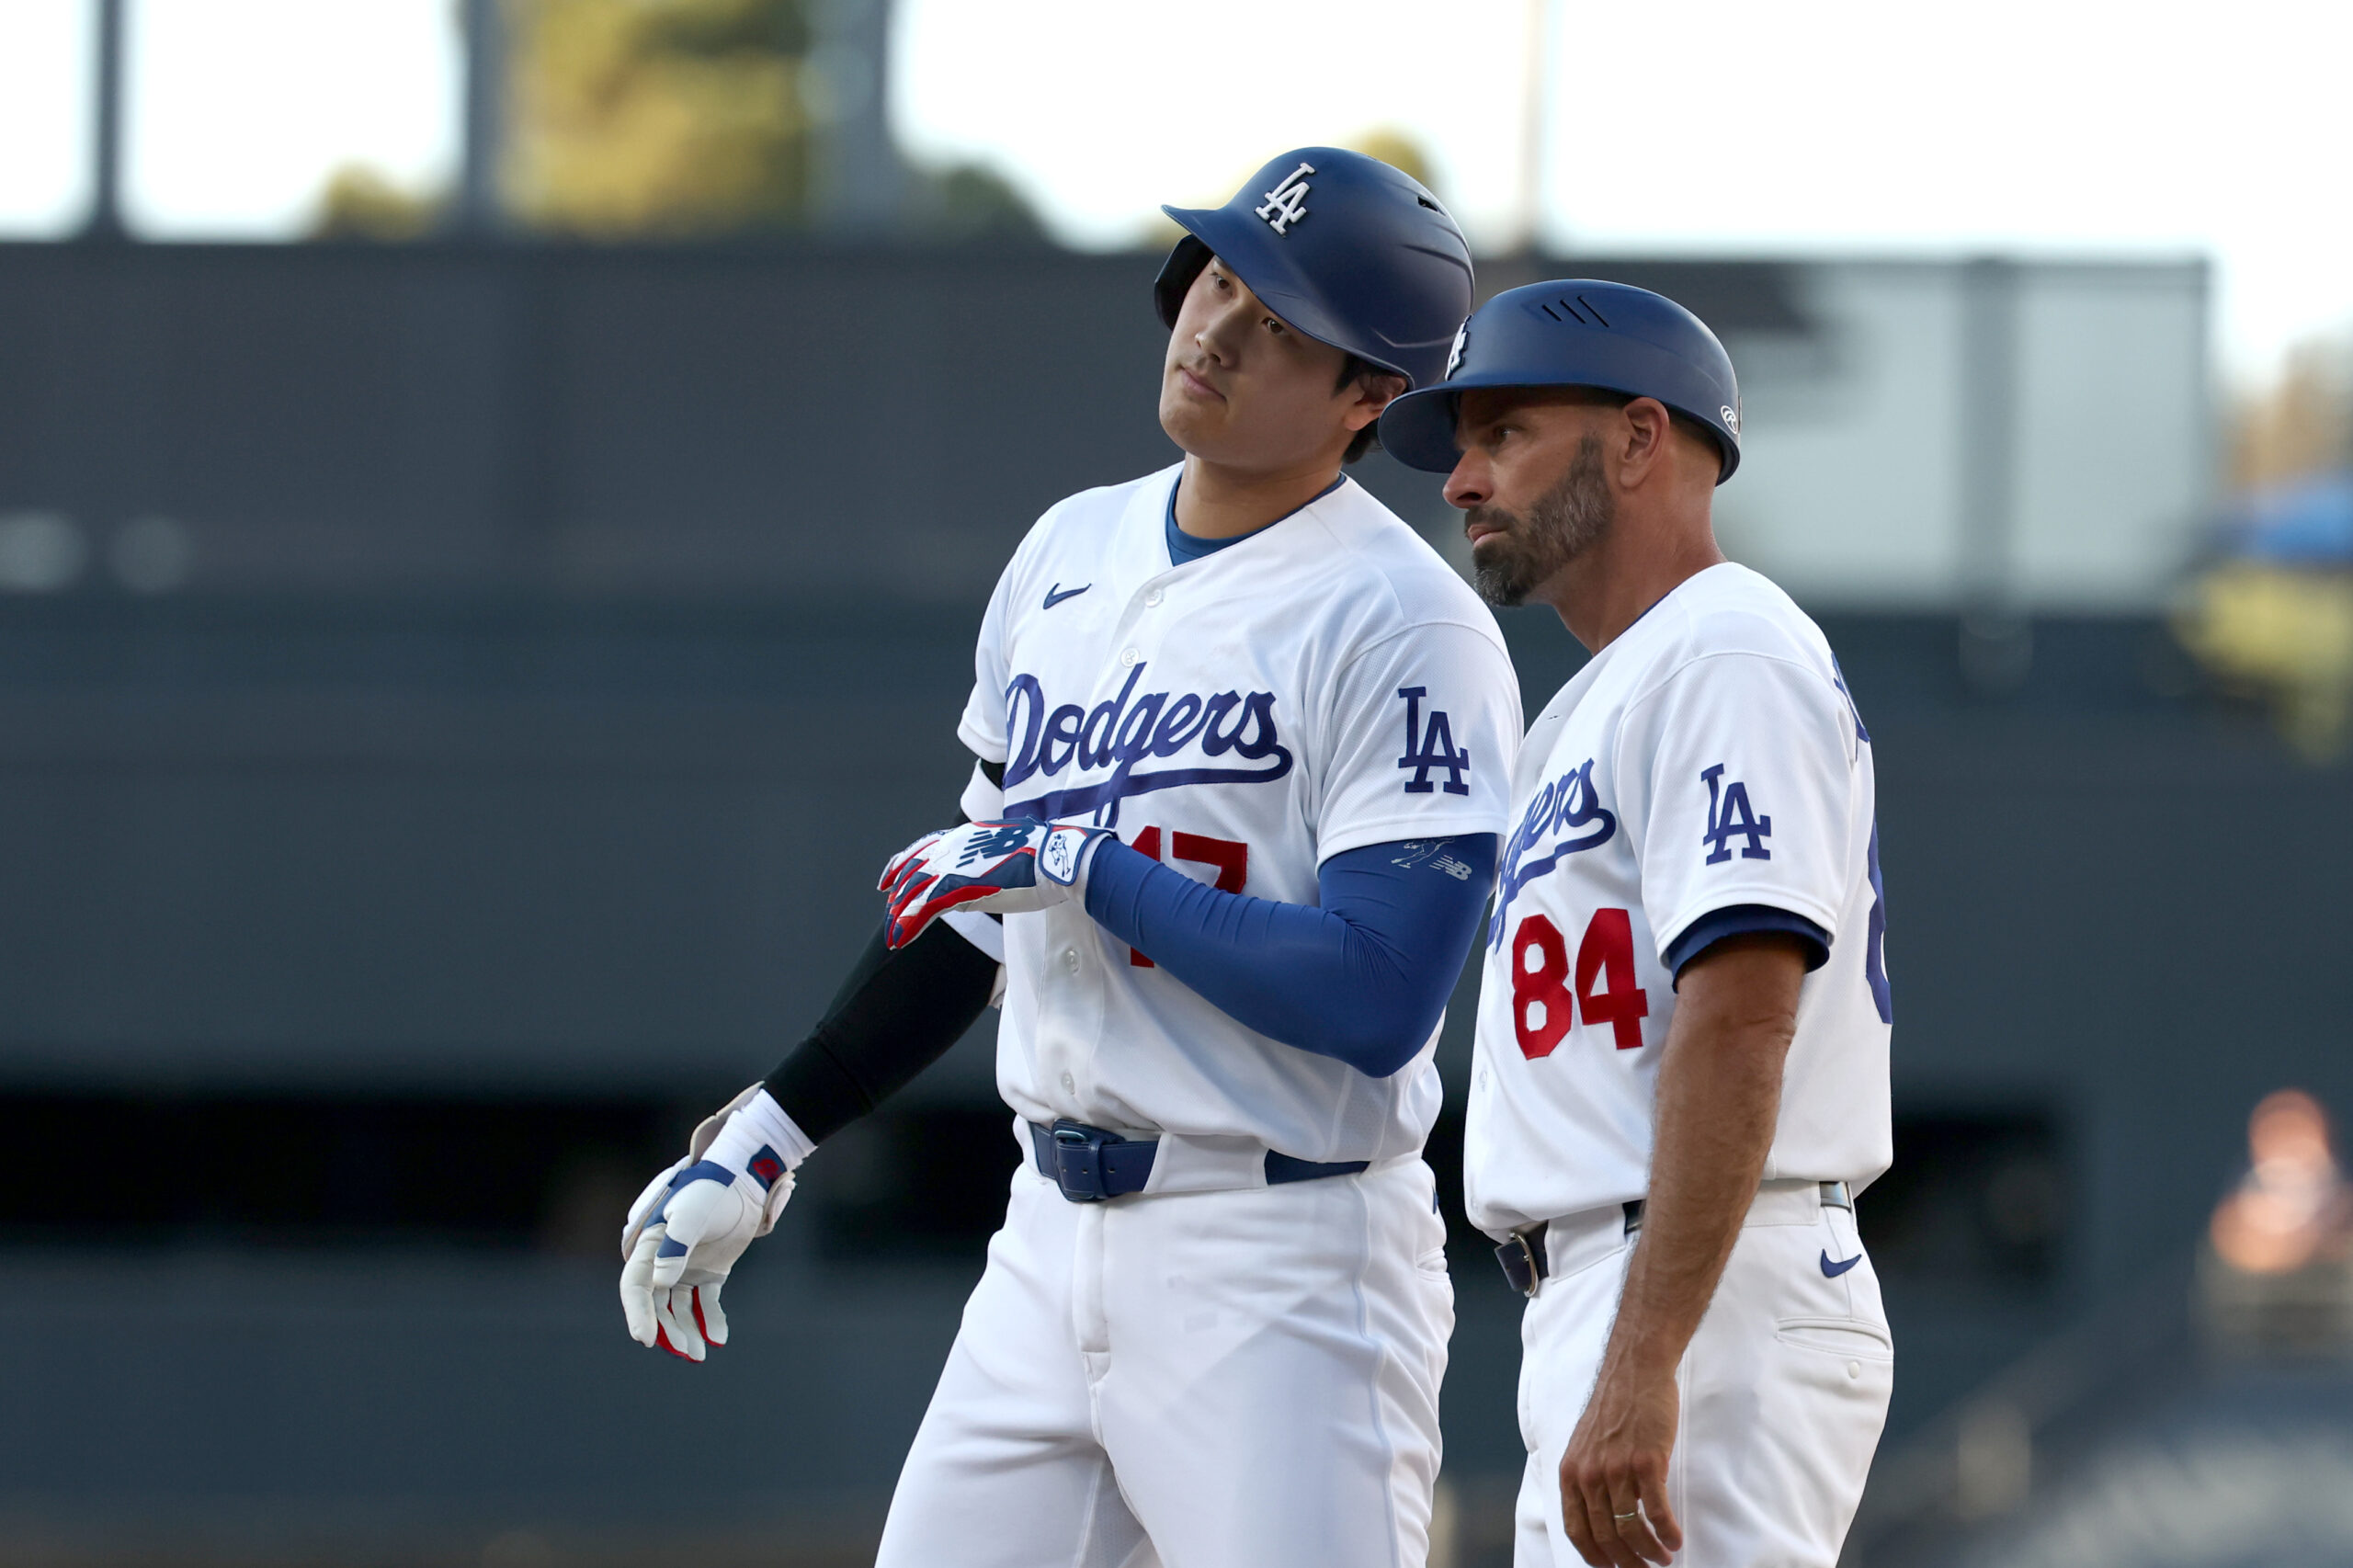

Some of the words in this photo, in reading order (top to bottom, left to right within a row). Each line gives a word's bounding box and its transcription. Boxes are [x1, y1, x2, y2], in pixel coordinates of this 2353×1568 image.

[1255, 162, 1315, 235] LA
[1002, 661, 1292, 829] Dodgers
[1397, 686, 1470, 796] LA
[1487, 757, 1616, 958] gers
[1700, 763, 1772, 866] LA
[1511, 907, 1649, 1061] 84
